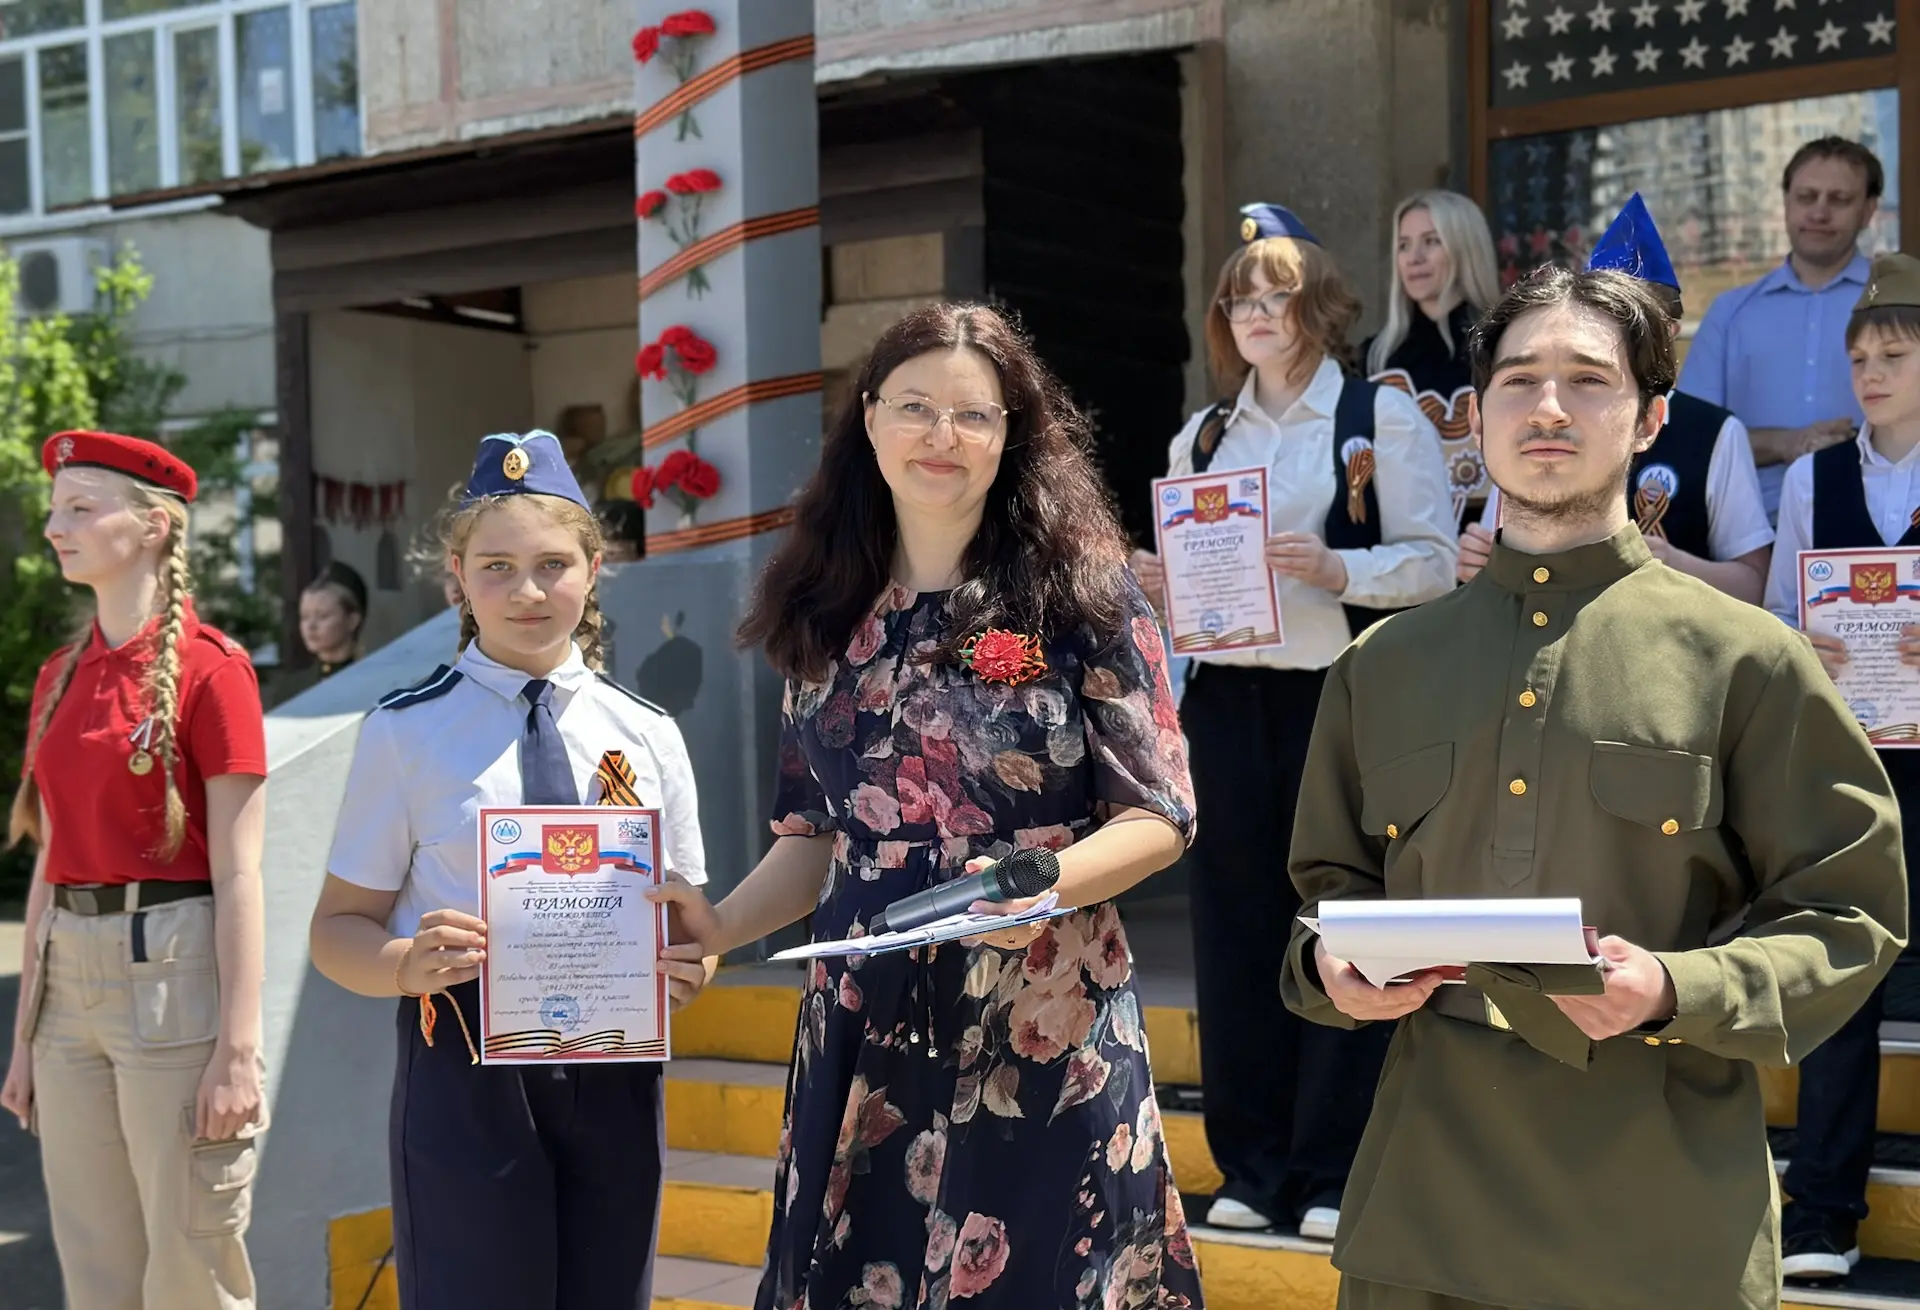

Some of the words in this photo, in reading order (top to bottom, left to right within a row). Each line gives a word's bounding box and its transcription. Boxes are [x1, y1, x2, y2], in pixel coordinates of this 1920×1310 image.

[1184, 535, 1244, 551] ГРАМОТА
[1834, 621, 1915, 633] ГРАМОТ
[523, 896, 623, 911] ГРАМОТА
[533, 912, 612, 920] НАГРАЖДАЕТСЯ
